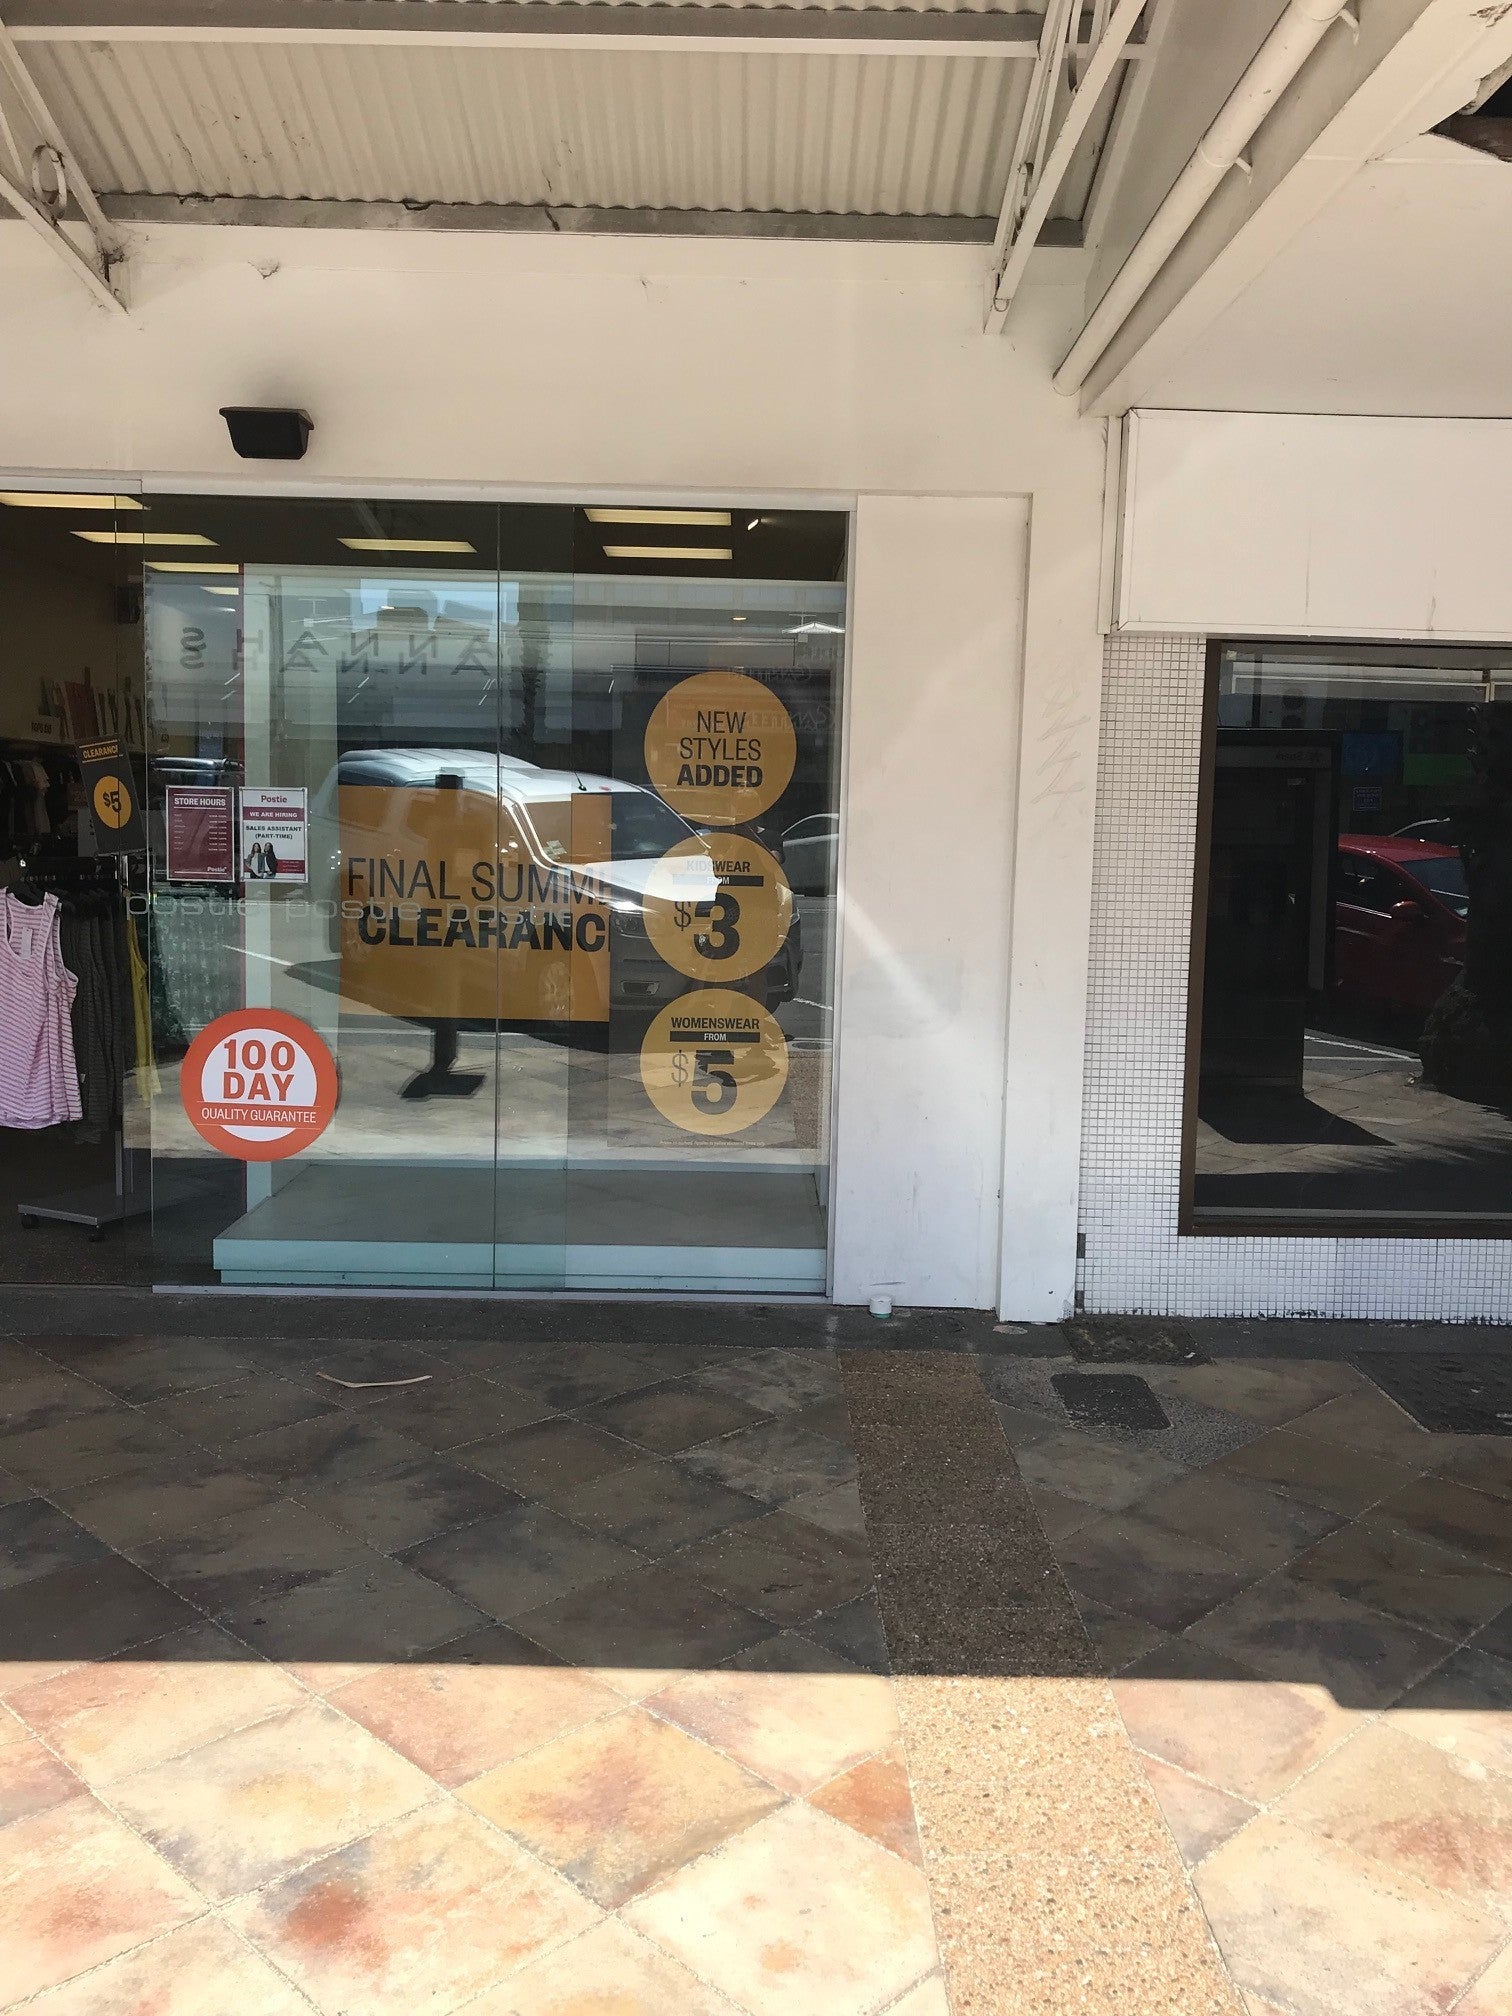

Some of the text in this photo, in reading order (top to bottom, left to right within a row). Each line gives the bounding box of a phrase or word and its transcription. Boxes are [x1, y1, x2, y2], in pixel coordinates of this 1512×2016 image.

[697, 710, 747, 734] NEW
[82, 744, 119, 760] CLEARANC
[679, 737, 762, 762] STYLES
[676, 763, 763, 788] ADDED
[102, 790, 122, 814] $5
[174, 797, 227, 807] STORE HOURS
[260, 794, 288, 804] Postie
[274, 811, 298, 819] HIRING
[348, 857, 461, 901] FINAL
[126, 888, 572, 929] postie postie postie
[358, 904, 612, 953] CLEARANC
[673, 892, 741, 961] $3
[671, 1016, 760, 1030] WOMENSWEAR
[703, 1032, 727, 1042] FROM
[223, 1038, 296, 1072] 100
[222, 1071, 295, 1102] DAY
[670, 1049, 738, 1116] $5
[201, 1107, 317, 1124] QUALITY GUARANTEE
